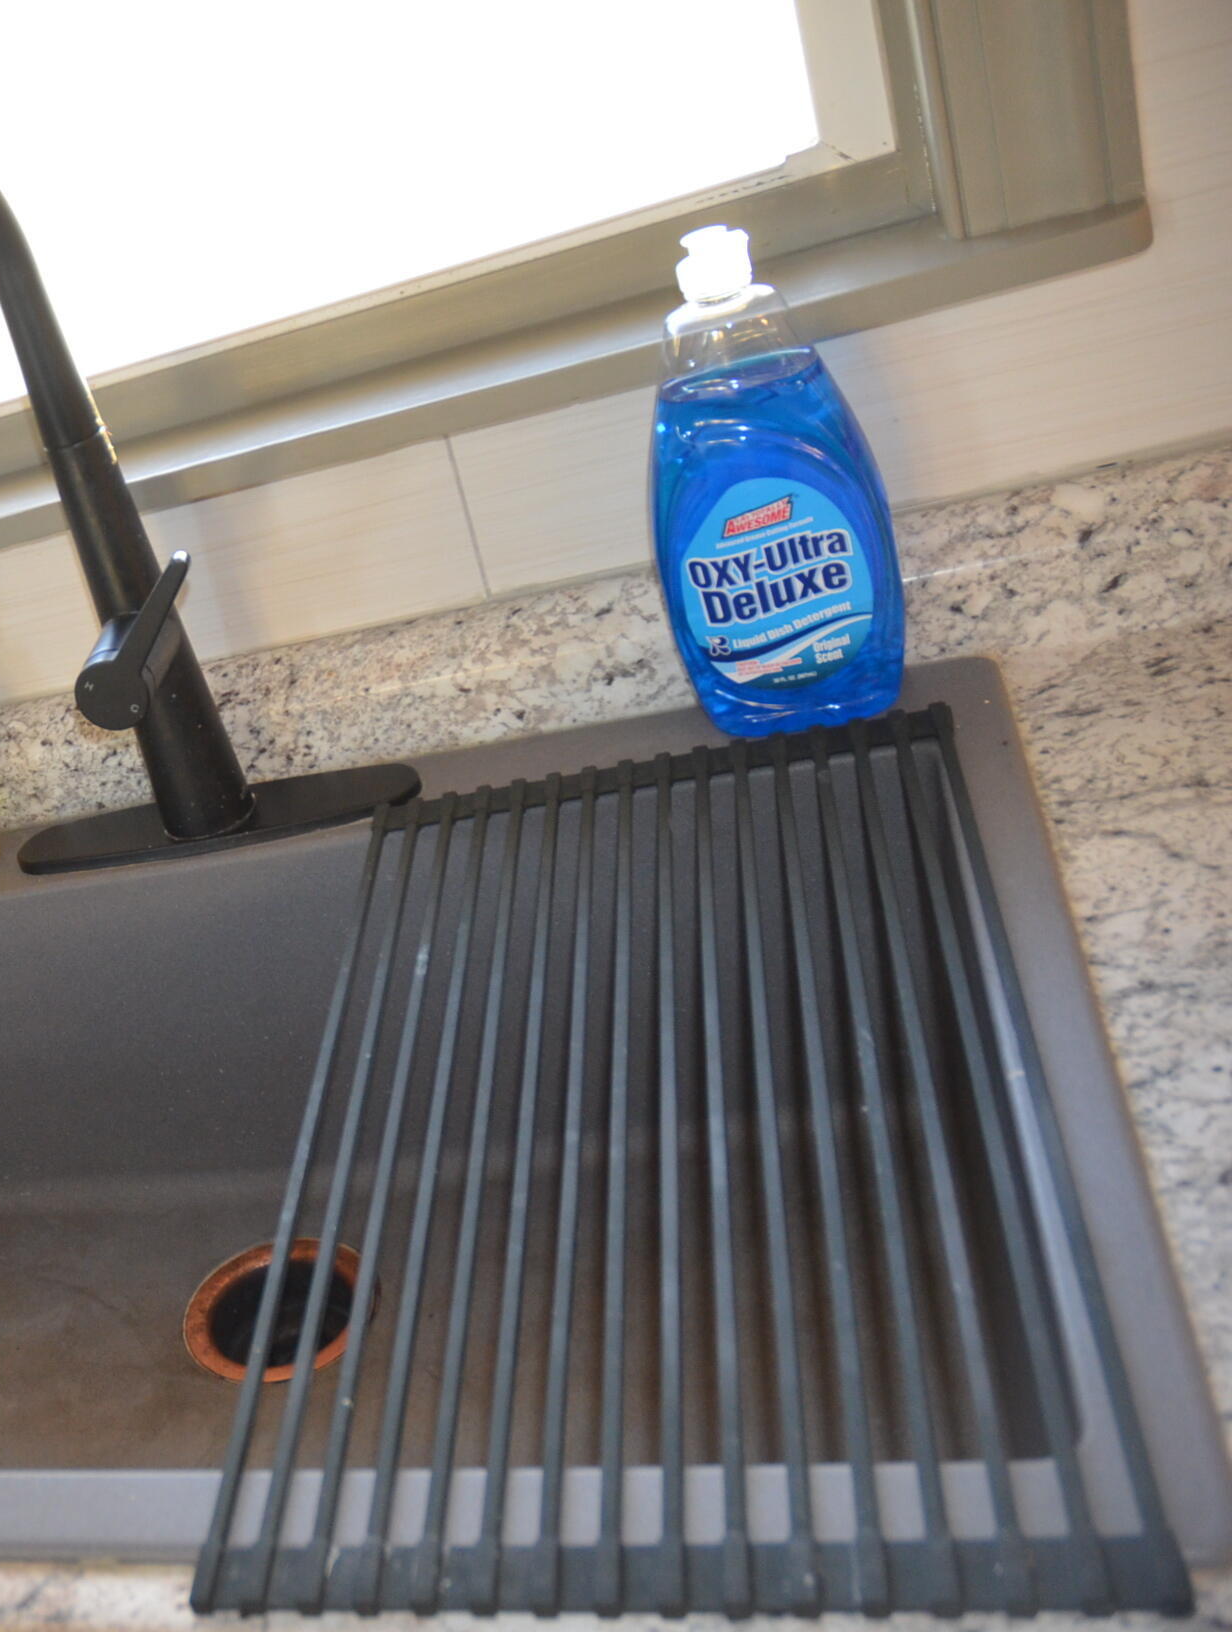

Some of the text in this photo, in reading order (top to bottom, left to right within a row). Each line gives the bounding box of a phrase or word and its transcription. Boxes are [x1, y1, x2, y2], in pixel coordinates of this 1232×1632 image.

[725, 505, 790, 536] AWESOME
[702, 562, 849, 625] Deluxe
[733, 601, 852, 649] Liquid Dish Detergent
[813, 633, 851, 664] Original Scent
